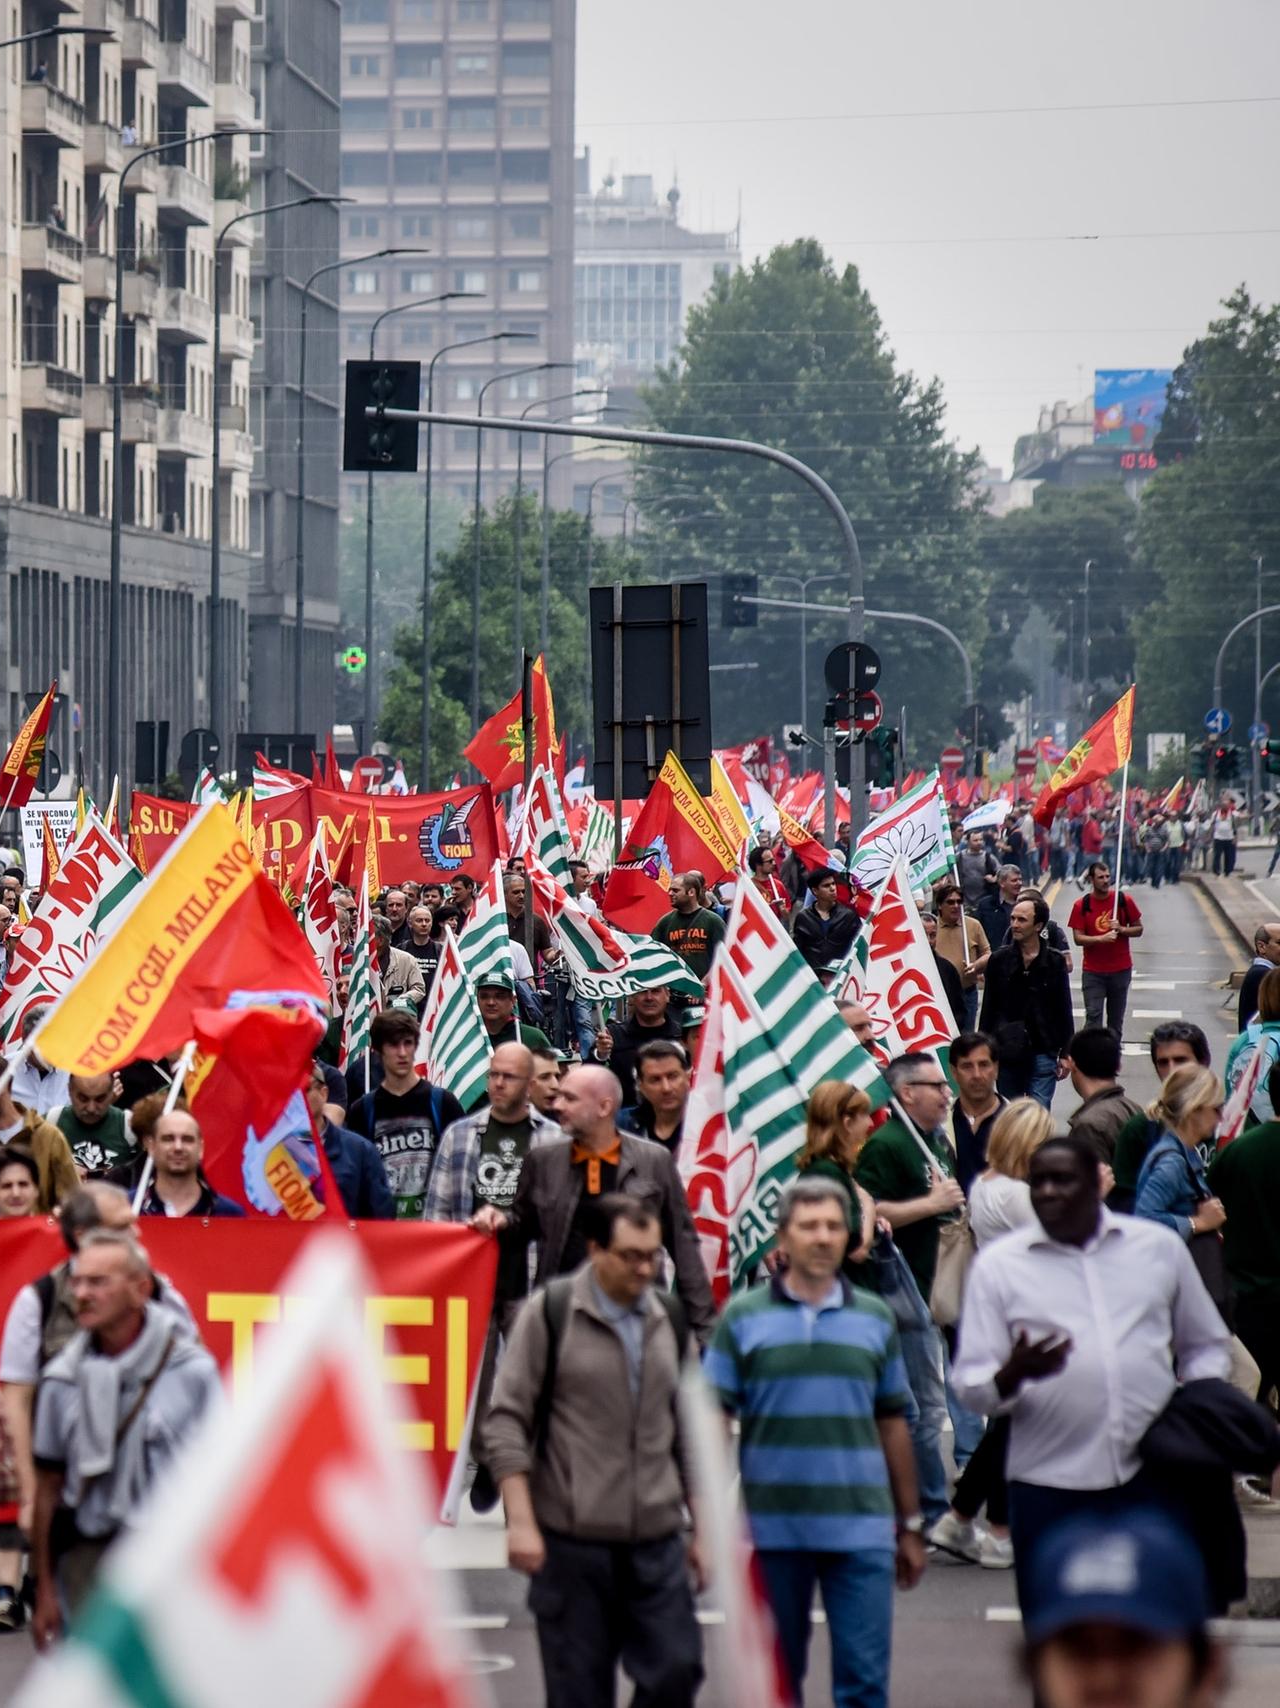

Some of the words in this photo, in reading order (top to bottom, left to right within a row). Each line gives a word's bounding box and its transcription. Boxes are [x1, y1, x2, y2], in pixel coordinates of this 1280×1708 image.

[27, 810, 36, 818] SE
[445, 845, 473, 858] FIOM
[76, 1002, 138, 1070] FIOM
[126, 943, 176, 1007] CGIL
[163, 840, 254, 945] MILANO
[266, 1159, 317, 1220] FIOM
